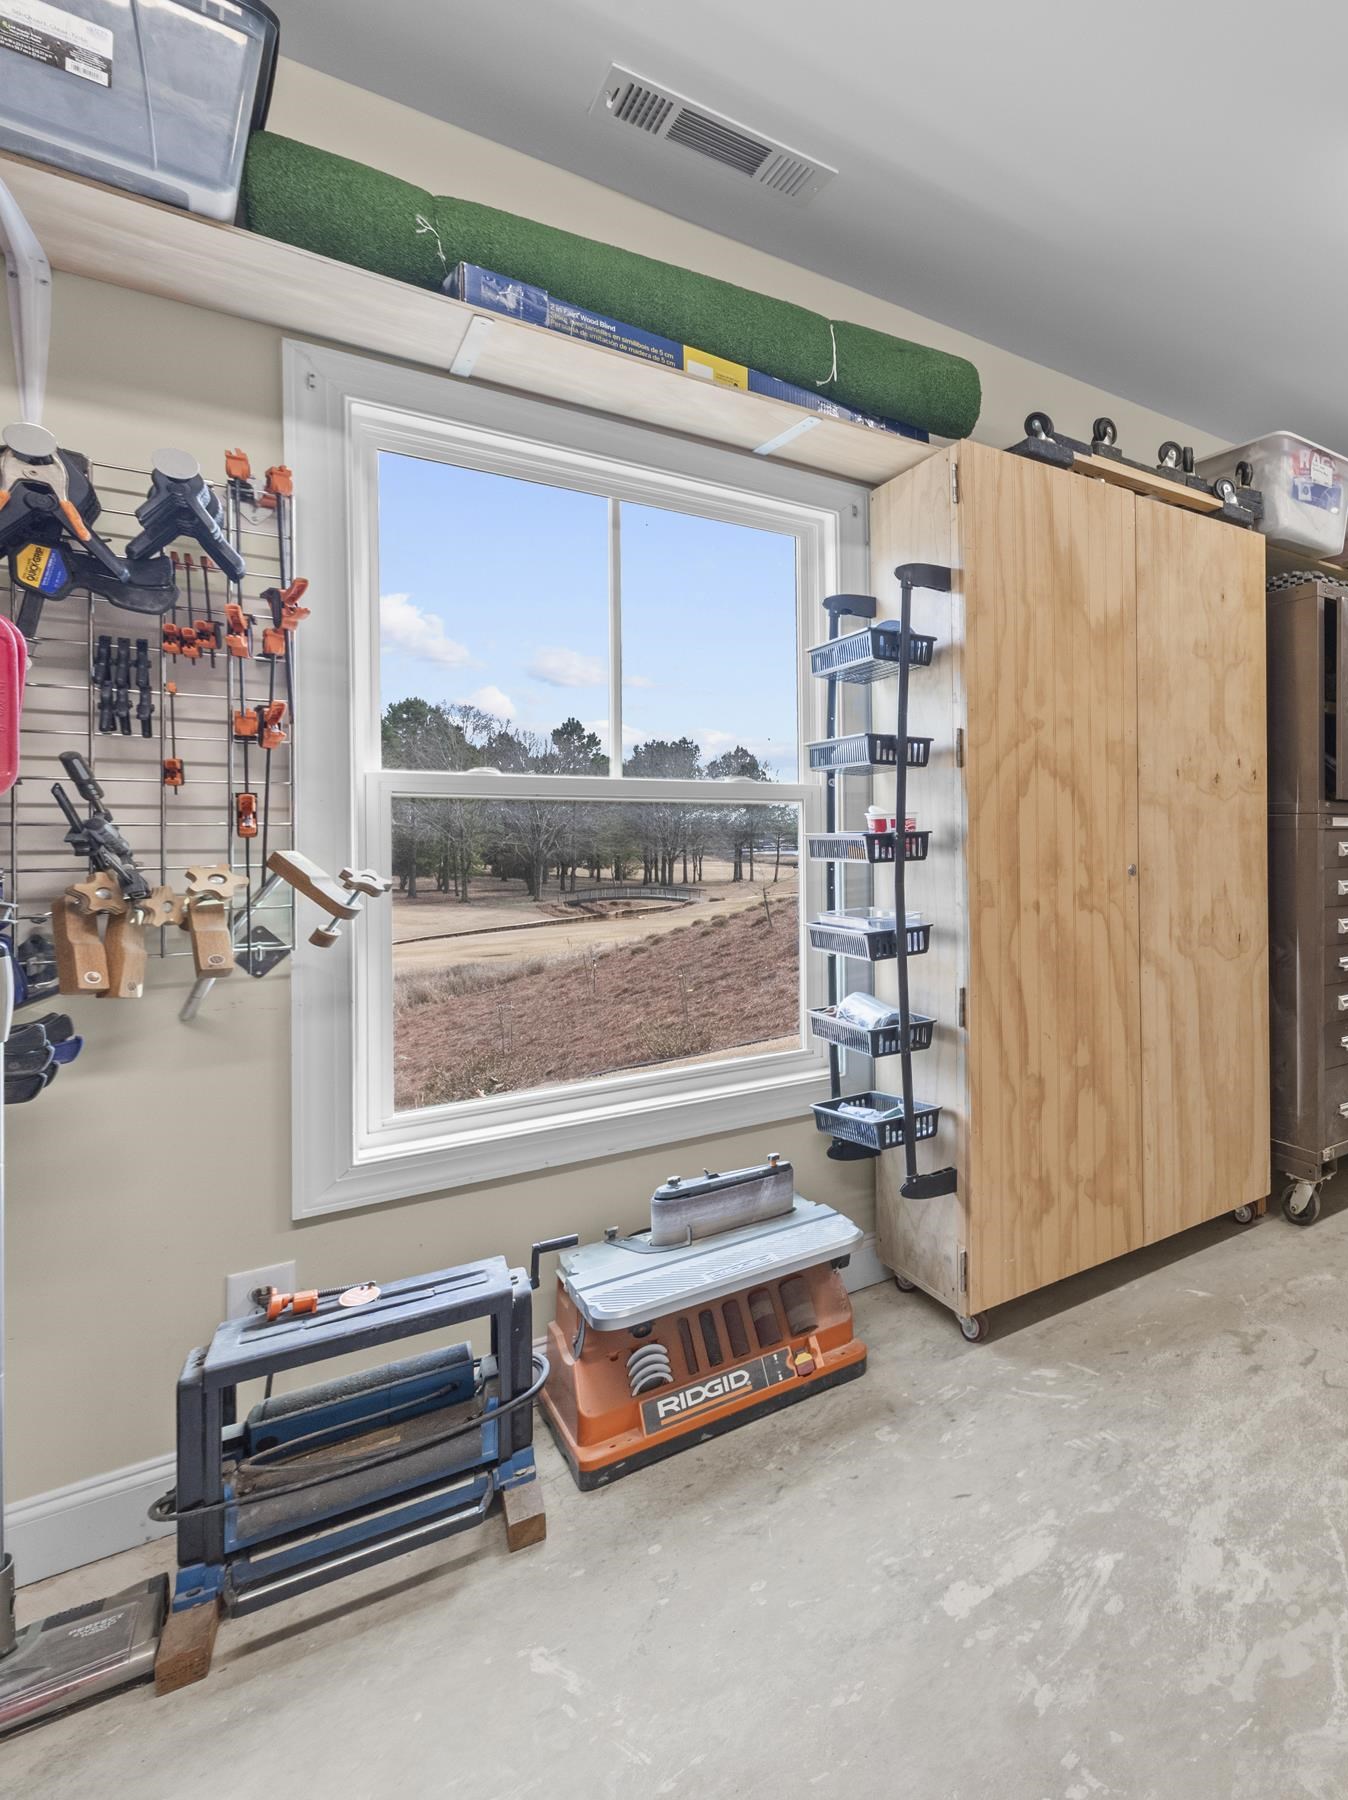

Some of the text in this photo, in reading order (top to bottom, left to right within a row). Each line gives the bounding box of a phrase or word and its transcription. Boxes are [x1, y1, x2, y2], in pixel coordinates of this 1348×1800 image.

[581, 314, 599, 326] Wood
[600, 320, 616, 332] Blind
[613, 333, 621, 341] en
[650, 345, 659, 353] de
[664, 351, 674, 359] cm
[619, 342, 628, 351] de
[652, 353, 661, 362] de
[666, 358, 676, 367] cm
[657, 1369, 751, 1418] RIDGID
